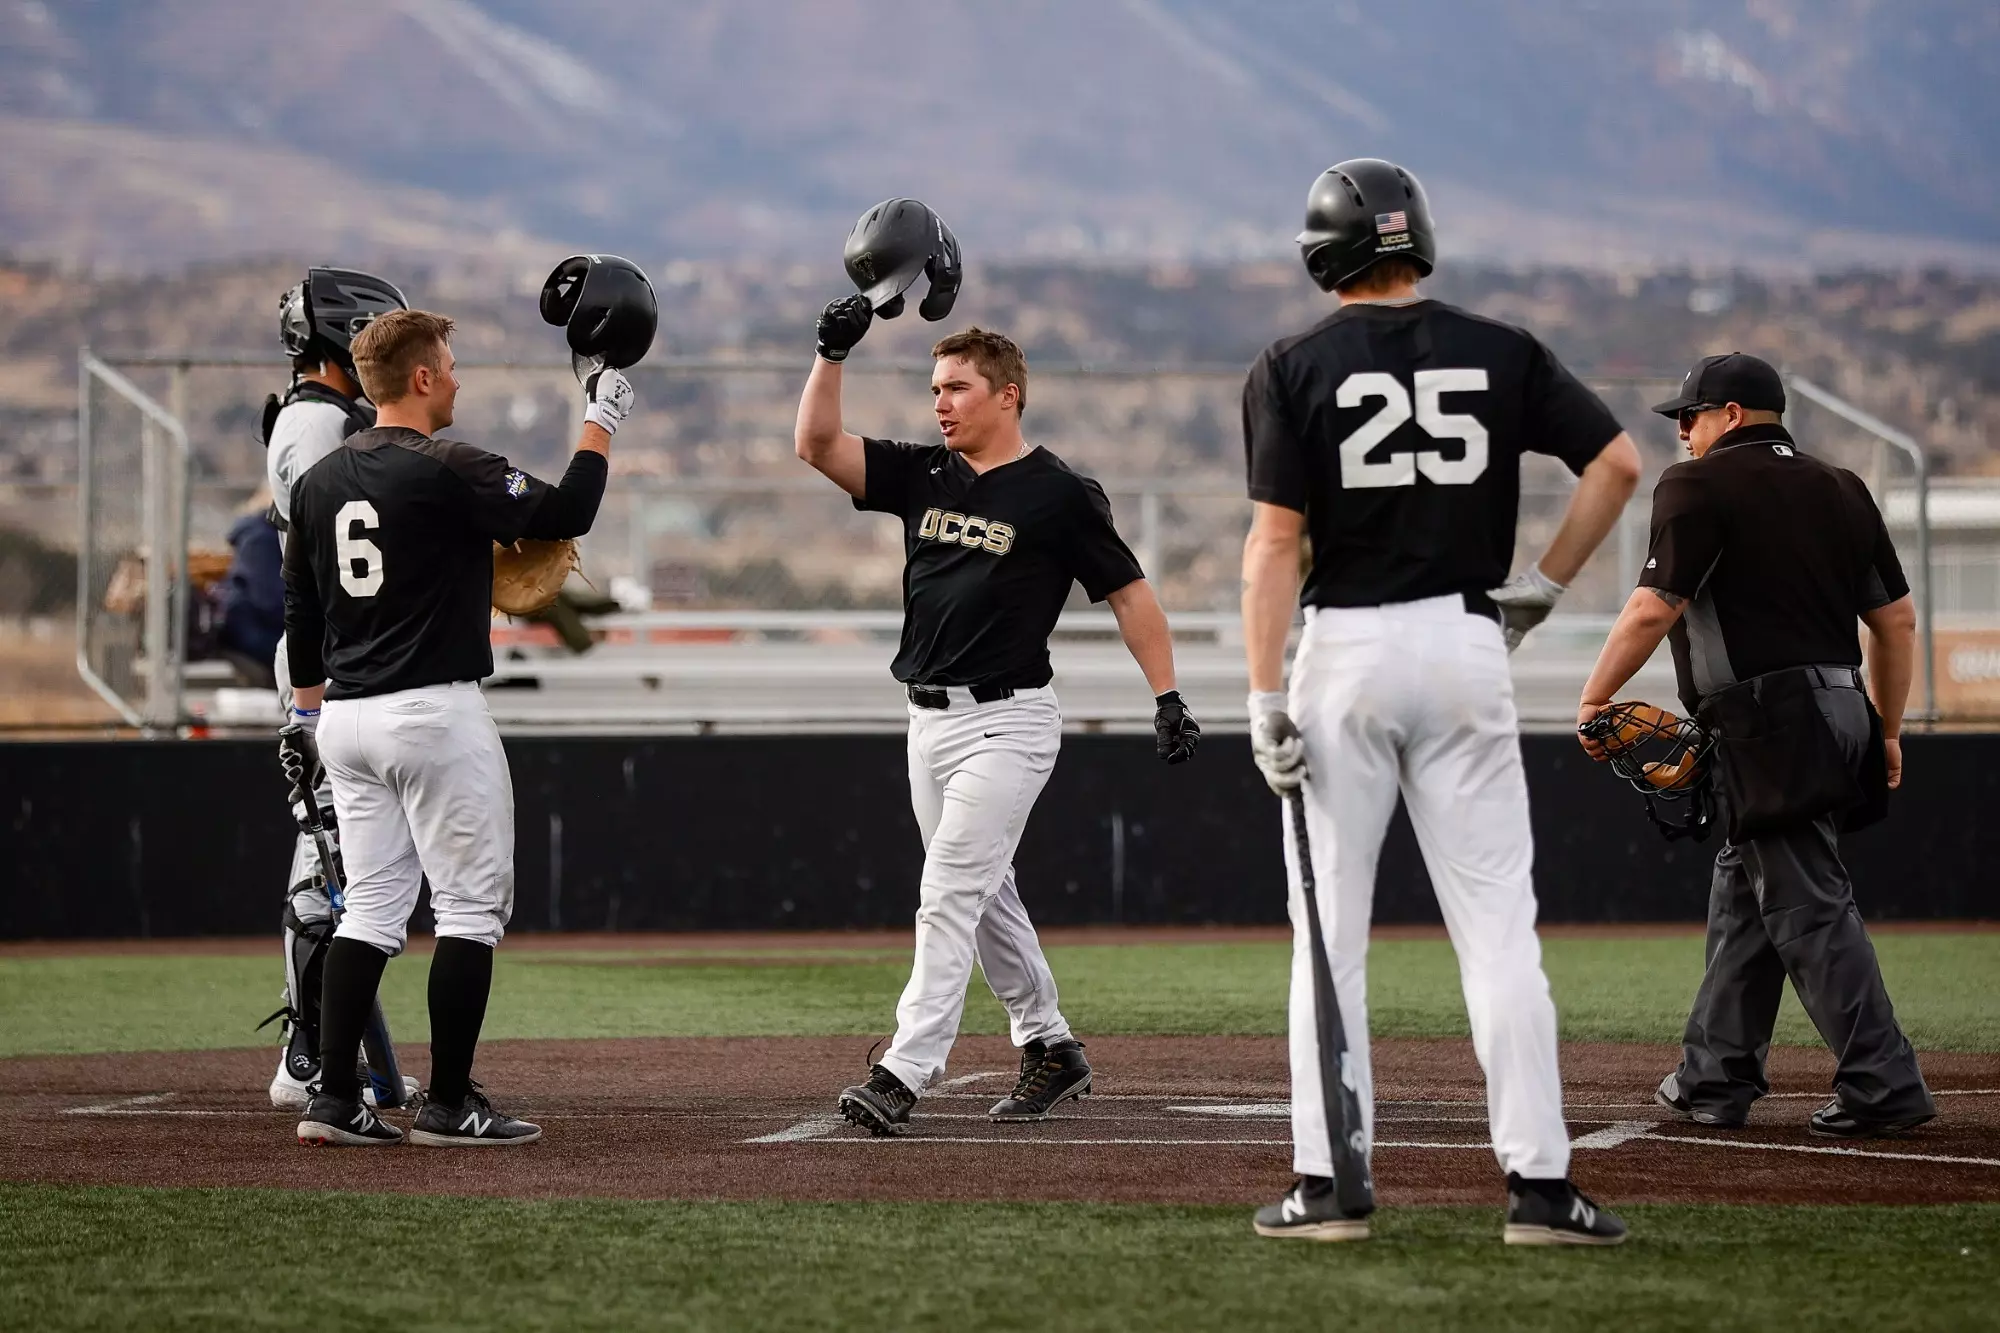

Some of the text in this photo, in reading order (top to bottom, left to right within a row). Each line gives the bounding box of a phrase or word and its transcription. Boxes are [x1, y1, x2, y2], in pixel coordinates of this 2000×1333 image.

[1381, 233, 1410, 245] UCCS
[1336, 368, 1489, 490] 25
[508, 471, 525, 497] RMAC
[335, 499, 384, 598] 6
[918, 506, 1017, 556] UCCS
[458, 1111, 493, 1137] N
